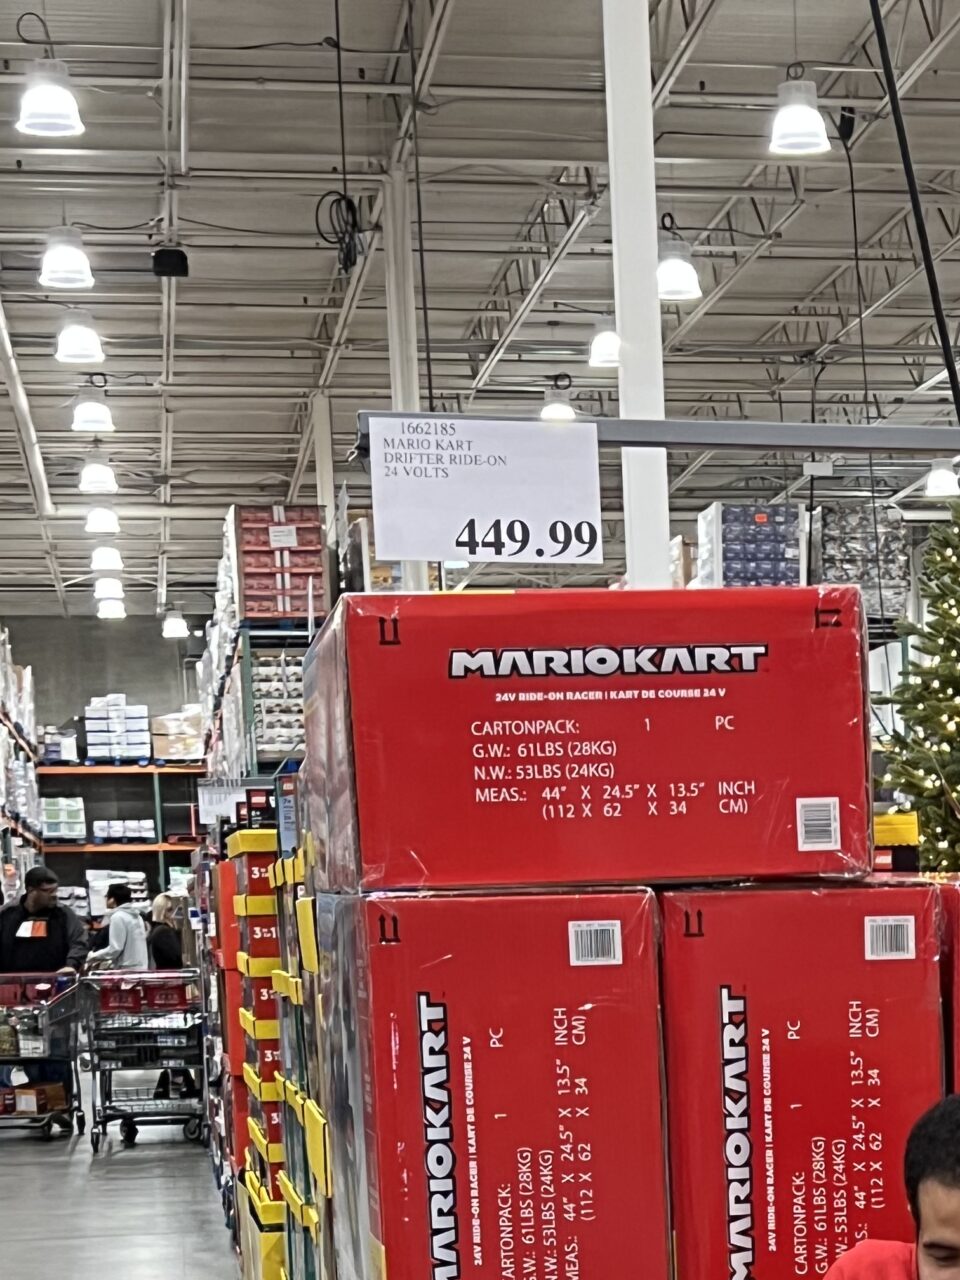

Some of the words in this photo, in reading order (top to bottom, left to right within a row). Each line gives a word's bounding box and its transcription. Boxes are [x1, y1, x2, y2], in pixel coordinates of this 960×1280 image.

[401, 422, 456, 436] 1662185
[384, 438, 430, 450] MARIO
[435, 439, 473, 451] KART
[384, 452, 445, 465] DRIFTER
[450, 454, 507, 466] RIDE-ON
[384, 466, 398, 477] 24
[404, 466, 449, 478] VOLTS
[455, 518, 598, 557] 449.99
[449, 644, 768, 679] MARIOKART
[496, 693, 516, 702] 24V
[518, 692, 565, 701] RIDE-ON
[566, 691, 602, 700] RACER
[610, 690, 639, 699] KART
[641, 690, 656, 698] DE
[658, 689, 701, 698] COURSE
[703, 689, 716, 697] 24
[718, 688, 726, 696] V
[471, 720, 580, 736] CARTONPACK:
[644, 718, 650, 731] 1
[715, 716, 735, 730] PC
[473, 744, 510, 757] G.W.:
[517, 742, 563, 757] 61LBS
[568, 741, 617, 758] (28KG)
[474, 766, 512, 780] N.W.:
[516, 764, 561, 779] 53LBS
[566, 762, 614, 779] (24KG)
[476, 788, 527, 802] MEAS.:
[581, 785, 591, 799] X
[647, 784, 657, 797] X
[718, 781, 755, 795] INCH
[542, 804, 575, 819] (112
[582, 803, 592, 817] X
[603, 803, 622, 817] 62
[648, 802, 657, 815] X
[669, 801, 687, 815] 34
[719, 800, 748, 814] CM)
[553, 1007, 568, 1045] INCH
[849, 1001, 862, 1037] INCH
[865, 1009, 880, 1037] CM)
[463, 1036, 471, 1044] V
[490, 1027, 504, 1048] PC
[571, 1016, 586, 1045] CM)
[787, 1020, 800, 1040] PC
[464, 1047, 471, 1060] 24
[464, 1062, 474, 1105] COURSE
[574, 1078, 588, 1095] 34
[867, 1069, 880, 1086] 34
[575, 1107, 589, 1117] X
[851, 1098, 864, 1107] X
[868, 1098, 881, 1107] X
[466, 1107, 475, 1122] DE
[558, 1108, 572, 1118] X
[467, 1124, 477, 1153] KART
[869, 1132, 882, 1150] 62
[577, 1143, 591, 1161] 62
[811, 1137, 826, 1183] (28KG)
[517, 1147, 534, 1195] (28KG)
[831, 1139, 847, 1186] (24KG)
[853, 1162, 866, 1171] X
[870, 1161, 882, 1171] X
[470, 1160, 479, 1197] RACER
[539, 1150, 556, 1197] (24KG)
[562, 1173, 575, 1183] X
[578, 1172, 592, 1182] X
[870, 1177, 885, 1209] (112
[579, 1189, 596, 1221] (112
[813, 1187, 827, 1231] 61LBS
[833, 1190, 847, 1233] 53LBS
[470, 1198, 480, 1243] RIDE-ON
[520, 1199, 535, 1244] 61LBS
[541, 1202, 557, 1246] 53LBS
[792, 1171, 807, 1275] CARTONPACK:
[474, 1246, 482, 1266] 24V
